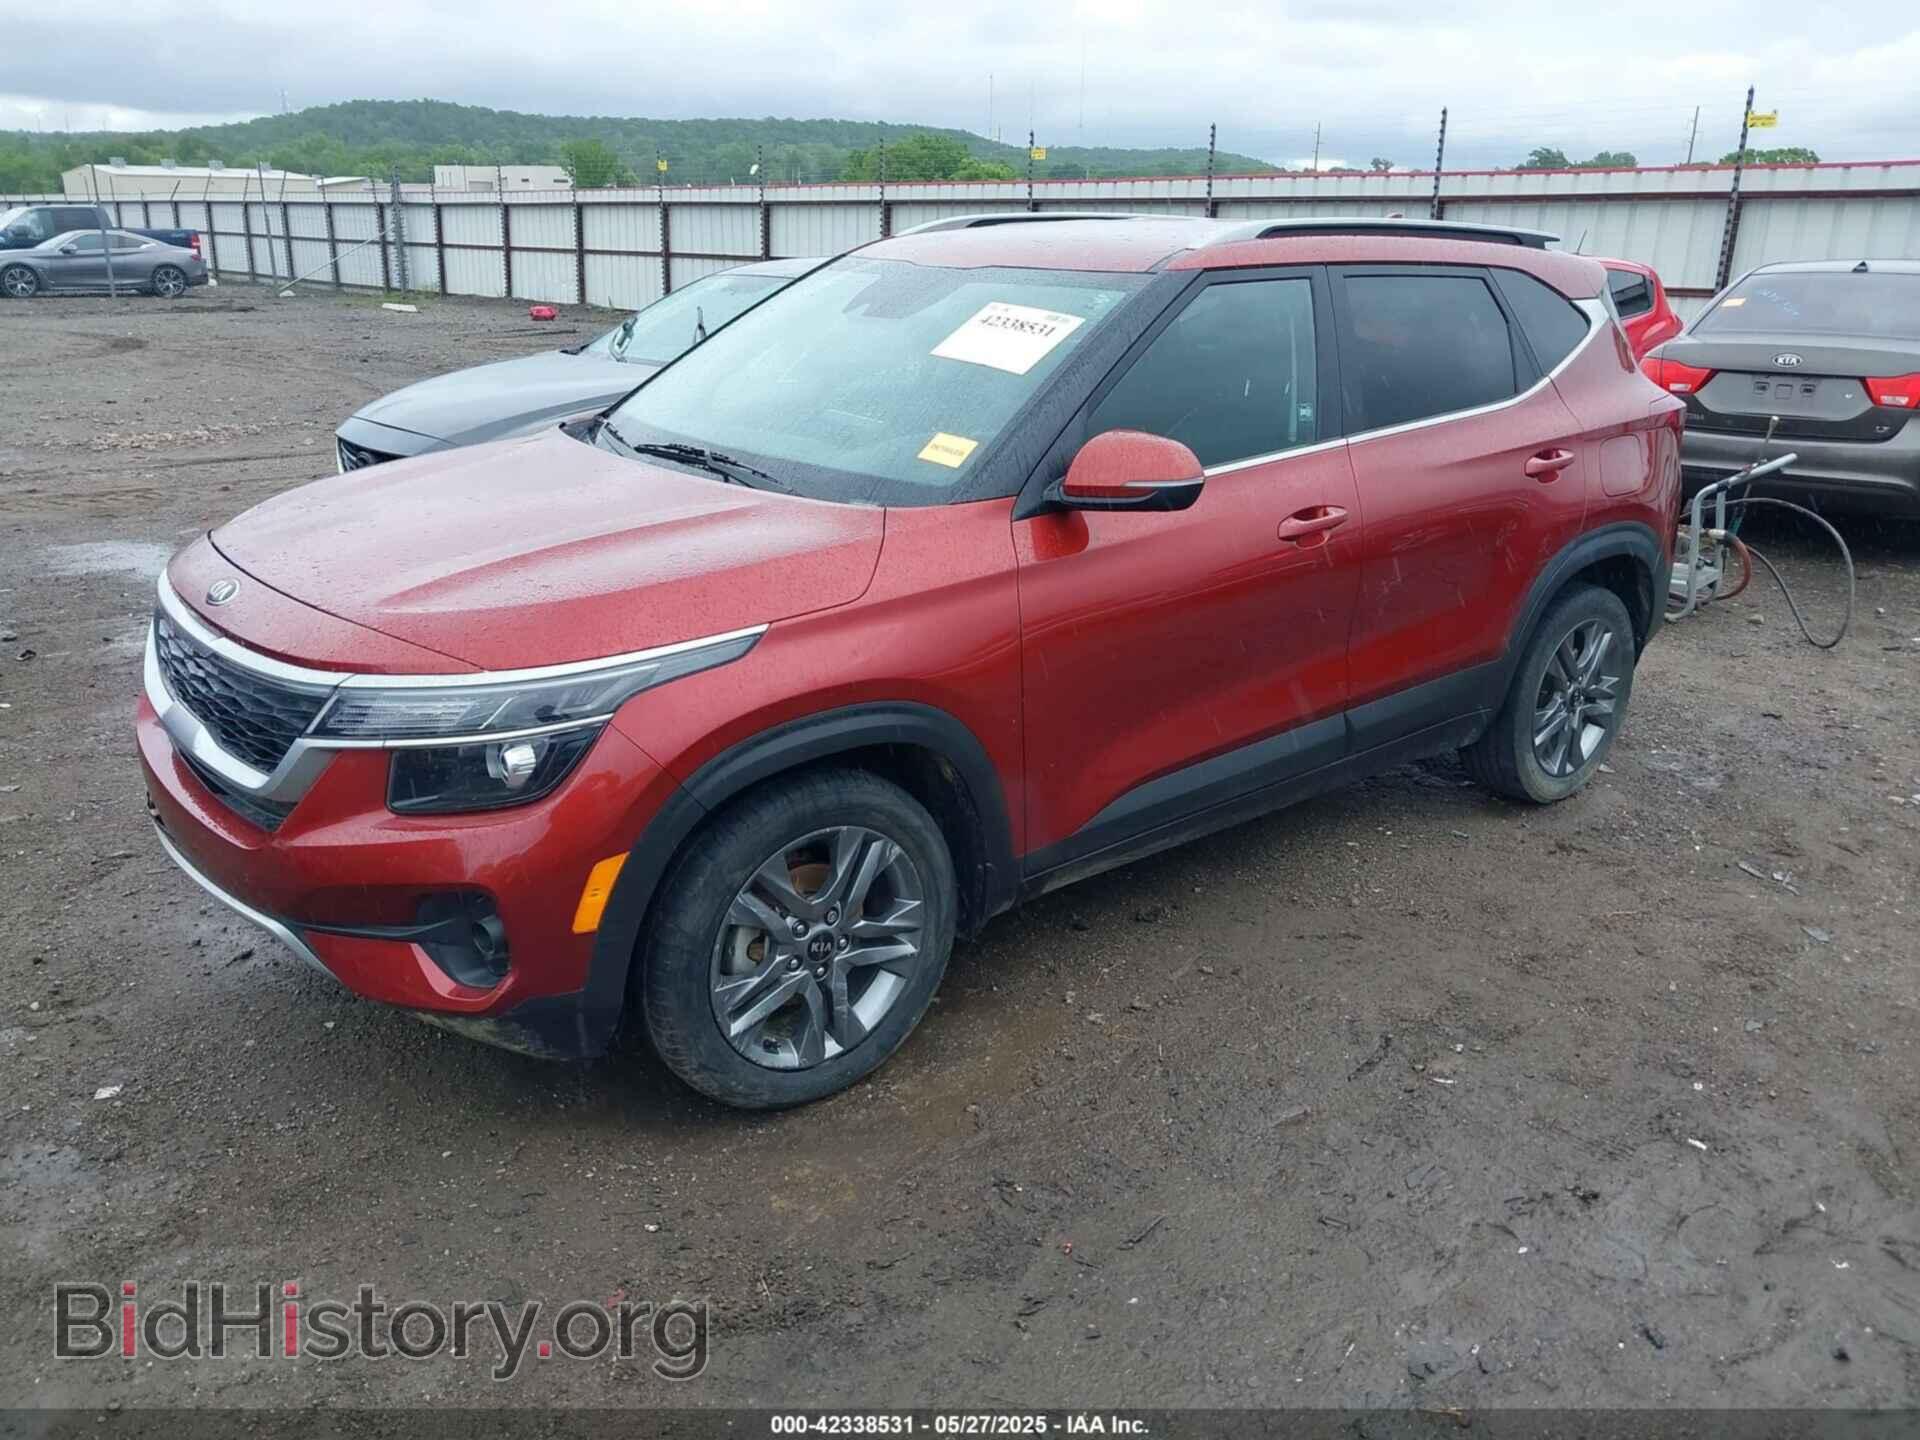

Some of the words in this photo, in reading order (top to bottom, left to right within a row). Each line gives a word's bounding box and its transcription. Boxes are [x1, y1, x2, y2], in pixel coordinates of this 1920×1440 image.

[979, 314, 1056, 337] 42338531
[1776, 356, 1797, 367] KIA
[811, 942, 832, 952] KIA
